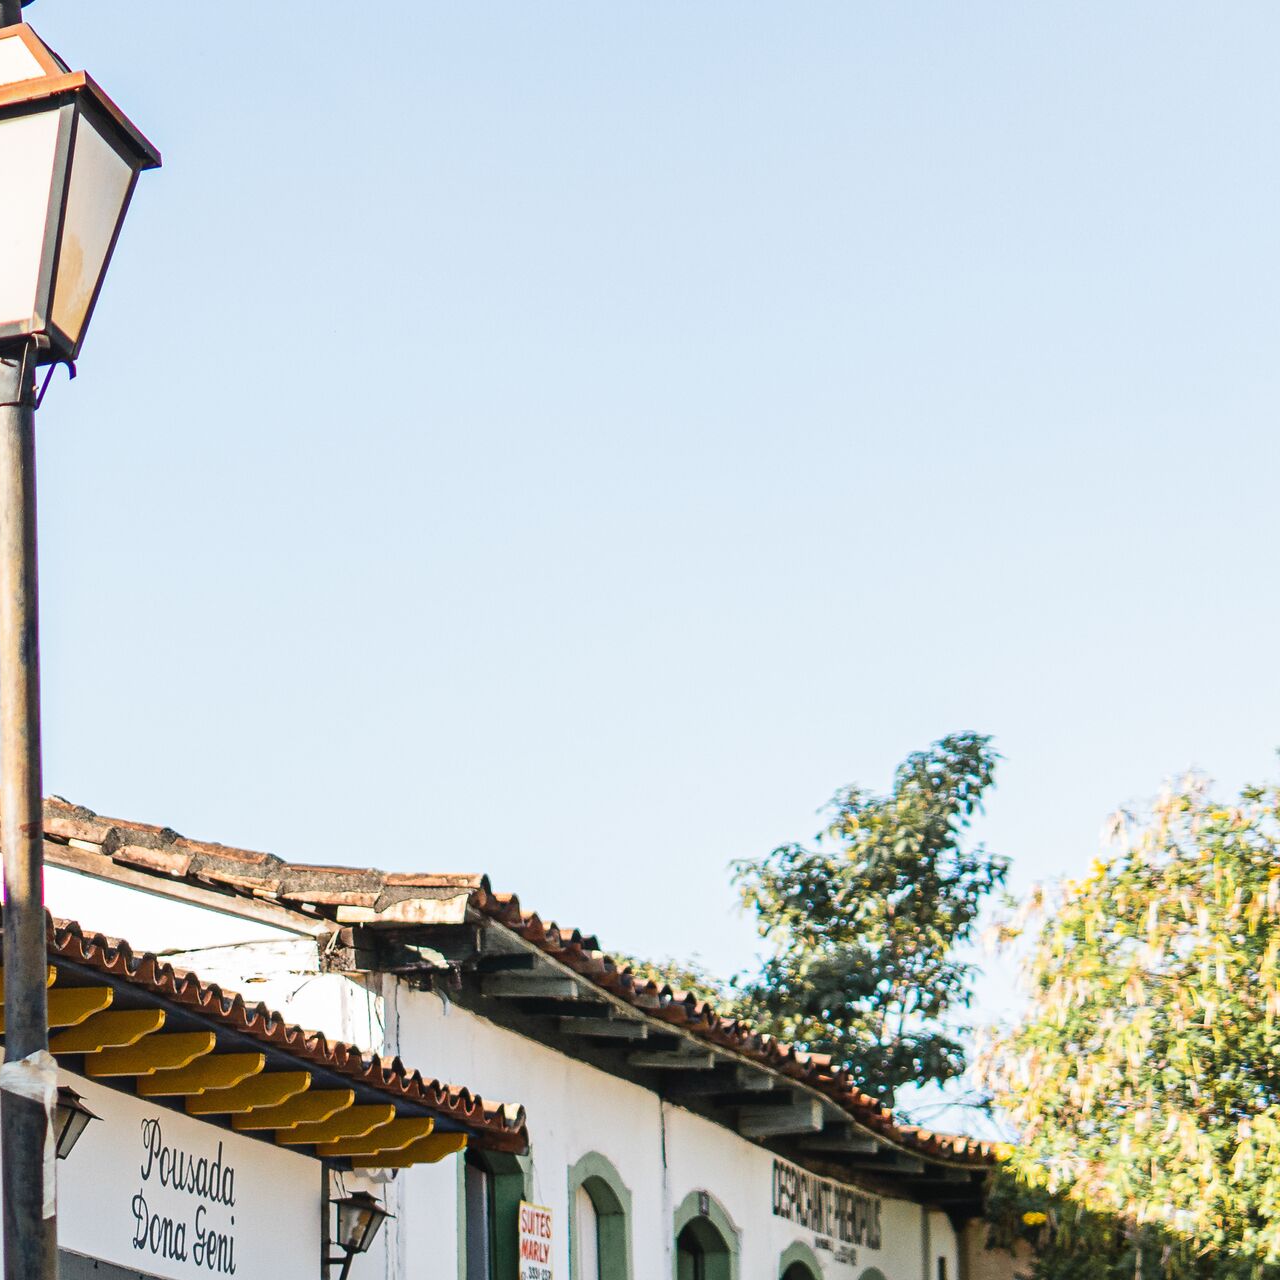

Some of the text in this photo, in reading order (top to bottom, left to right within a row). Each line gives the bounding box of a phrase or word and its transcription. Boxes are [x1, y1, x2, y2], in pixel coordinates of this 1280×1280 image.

[140, 1116, 236, 1207] Pousada
[132, 1187, 236, 1275] Dona Geni
[520, 1238, 551, 1264] MARLY
[521, 1208, 552, 1240] SUITES
